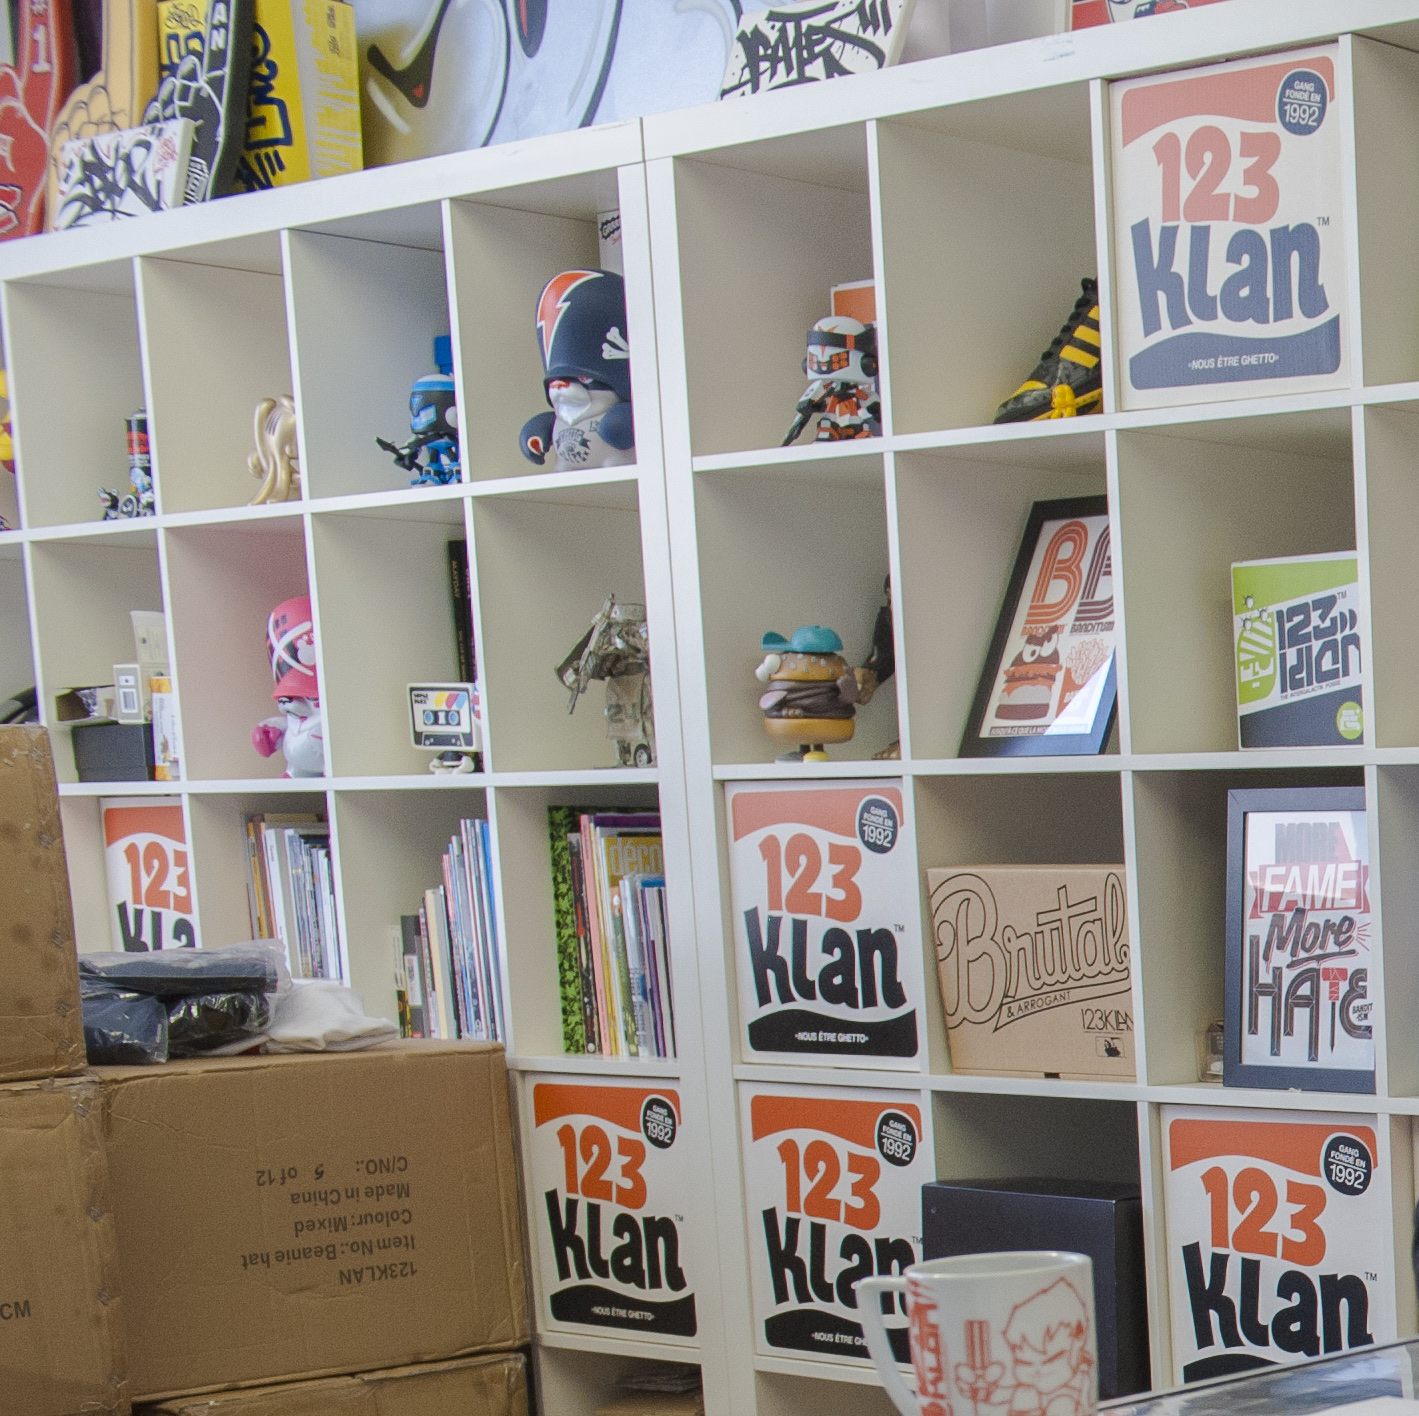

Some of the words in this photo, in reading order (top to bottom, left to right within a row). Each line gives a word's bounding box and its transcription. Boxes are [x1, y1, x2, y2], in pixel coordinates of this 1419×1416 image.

[1294, 80, 1315, 92] GANG
[1311, 93, 1321, 102] EN
[1283, 103, 1319, 126] 1992
[1152, 126, 1281, 224] 123
[862, 825, 892, 847] 1992
[1275, 822, 1340, 864] MORE
[611, 838, 662, 877] déco
[758, 833, 862, 922] 123
[1262, 864, 1358, 911] FAME
[1263, 907, 1355, 968] More
[929, 872, 1131, 1030] Brutal
[1017, 991, 1071, 1014] ARROGANT
[1248, 935, 1373, 1062] HATE
[1081, 1008, 1133, 1031] 123KLAN
[646, 1121, 671, 1144] 1992
[882, 1137, 911, 1161] 1992
[1339, 1144, 1359, 1157] GANG
[314, 1164, 324, 1180] 5
[557, 1124, 647, 1210] 123
[1355, 1159, 1366, 1168] EN
[256, 1170, 276, 1186] 12
[280, 1167, 297, 1186] of
[777, 1138, 880, 1231] 123
[1330, 1164, 1364, 1189] 1992
[290, 1189, 341, 1206] China
[345, 1187, 360, 1202] in
[364, 1183, 410, 1202] Made
[294, 1216, 347, 1238] Mixed
[351, 1209, 412, 1227] Colour:
[1200, 1166, 1326, 1267] 123
[377, 1235, 415, 1250] Item
[241, 1253, 271, 1270] hat
[275, 1244, 337, 1265] Beanie
[339, 1262, 418, 1285] 123KLAN
[0, 1300, 31, 1320] CM
